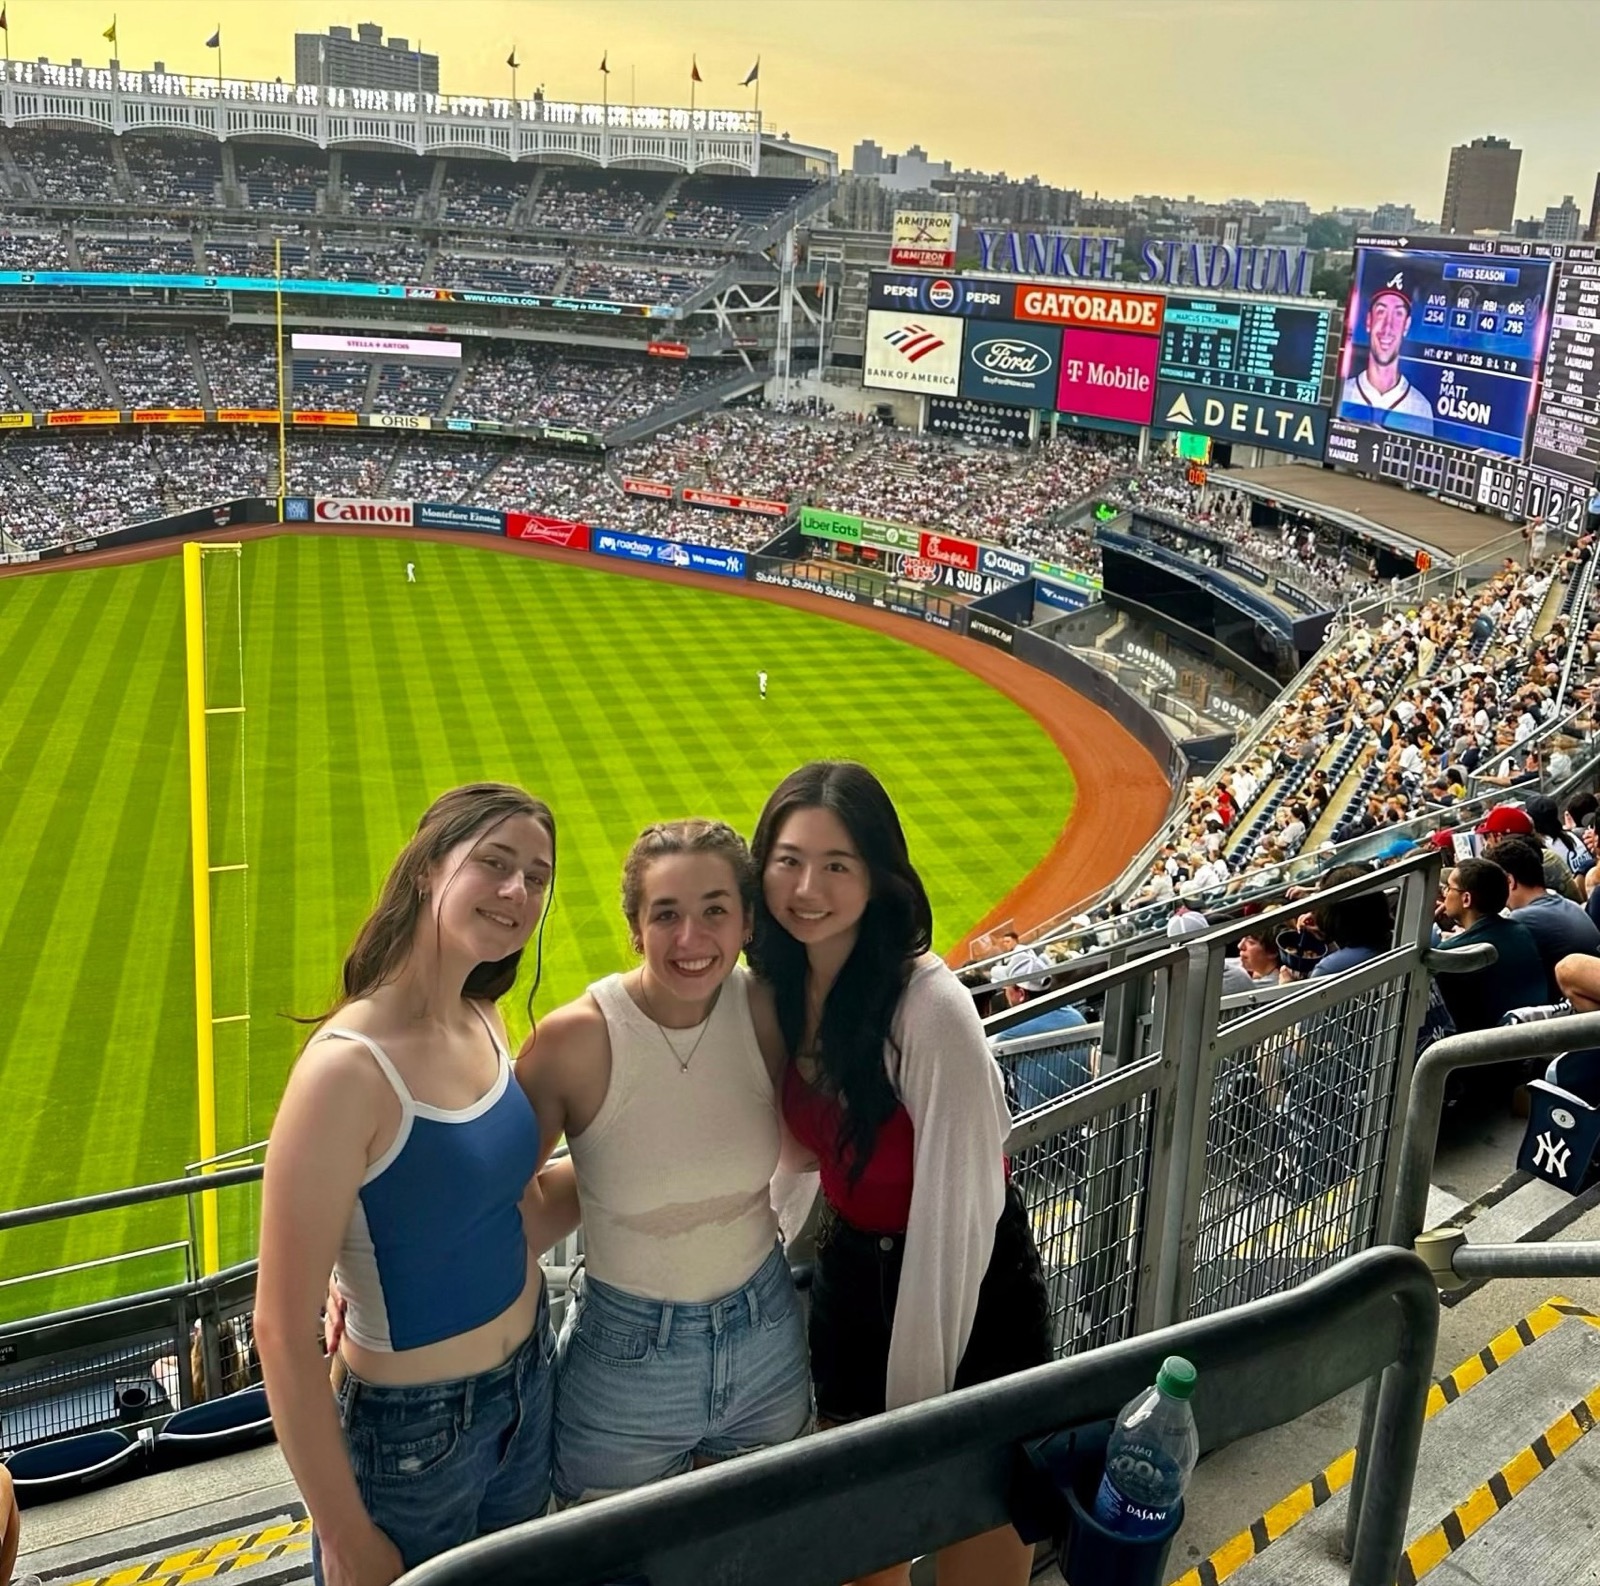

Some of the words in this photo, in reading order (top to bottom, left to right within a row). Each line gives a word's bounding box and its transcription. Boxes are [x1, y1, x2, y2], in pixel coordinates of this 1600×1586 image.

[896, 216, 951, 228] ARMITRON
[896, 250, 945, 261] ARMITRON
[977, 229, 1123, 280] YANKEE
[1139, 240, 1316, 296] STADIUM
[1457, 268, 1475, 280] THIS
[1475, 269, 1506, 282] SEASON
[463, 294, 540, 307] WWW.LOBELS.COM
[884, 285, 917, 297] PEPSI
[966, 292, 1000, 304] PEPSI
[1024, 291, 1158, 326] GATORADE
[1427, 294, 1446, 306] AVG
[1457, 298, 1470, 309] HR
[1482, 300, 1497, 311] RBI
[1507, 302, 1525, 315] OPS
[1424, 310, 1444, 323] .254
[1456, 314, 1466, 326] 12
[1480, 317, 1494, 330] 40
[1503, 320, 1523, 334] .795
[347, 340, 374, 348] STELLA
[382, 342, 410, 350] ARTOIS
[985, 343, 1038, 372] Ford
[867, 368, 894, 378] BANK
[896, 371, 909, 380] OF
[911, 373, 956, 385] AMERICA
[1067, 360, 1083, 382] T
[1087, 362, 1150, 392] Mobile
[1441, 369, 1454, 384] 28
[1296, 387, 1316, 402] 7:21
[1439, 383, 1468, 399] MATT
[1437, 396, 1491, 425] OLSON
[381, 415, 420, 427] ORIS
[1204, 399, 1314, 446] DELTA
[1329, 434, 1357, 449] BRAVES
[1495, 472, 1500, 482] 1
[1504, 475, 1511, 486] 0
[1328, 447, 1359, 463] YANKEES
[1492, 491, 1498, 501] 0
[1501, 494, 1508, 505] 0
[316, 500, 411, 523] Canon
[421, 507, 468, 520] Montefiore
[469, 511, 501, 524] Einstein
[1532, 487, 1541, 516] 1
[1547, 492, 1563, 523] 2
[1568, 499, 1581, 531] 2
[525, 523, 570, 538] Budweiser
[803, 516, 829, 530] Uber
[832, 521, 859, 537] Eats
[616, 539, 653, 555] roadway
[692, 554, 704, 564] We
[705, 558, 726, 568] move
[997, 556, 1026, 576] coupa
[755, 572, 790, 587] StubHub
[791, 578, 823, 595] StubHub
[825, 586, 856, 602] StubHub
[944, 567, 954, 587] A
[956, 571, 983, 593] SUB
[1051, 593, 1085, 608] AMTRAK
[1126, 1504, 1167, 1520] DASANI
